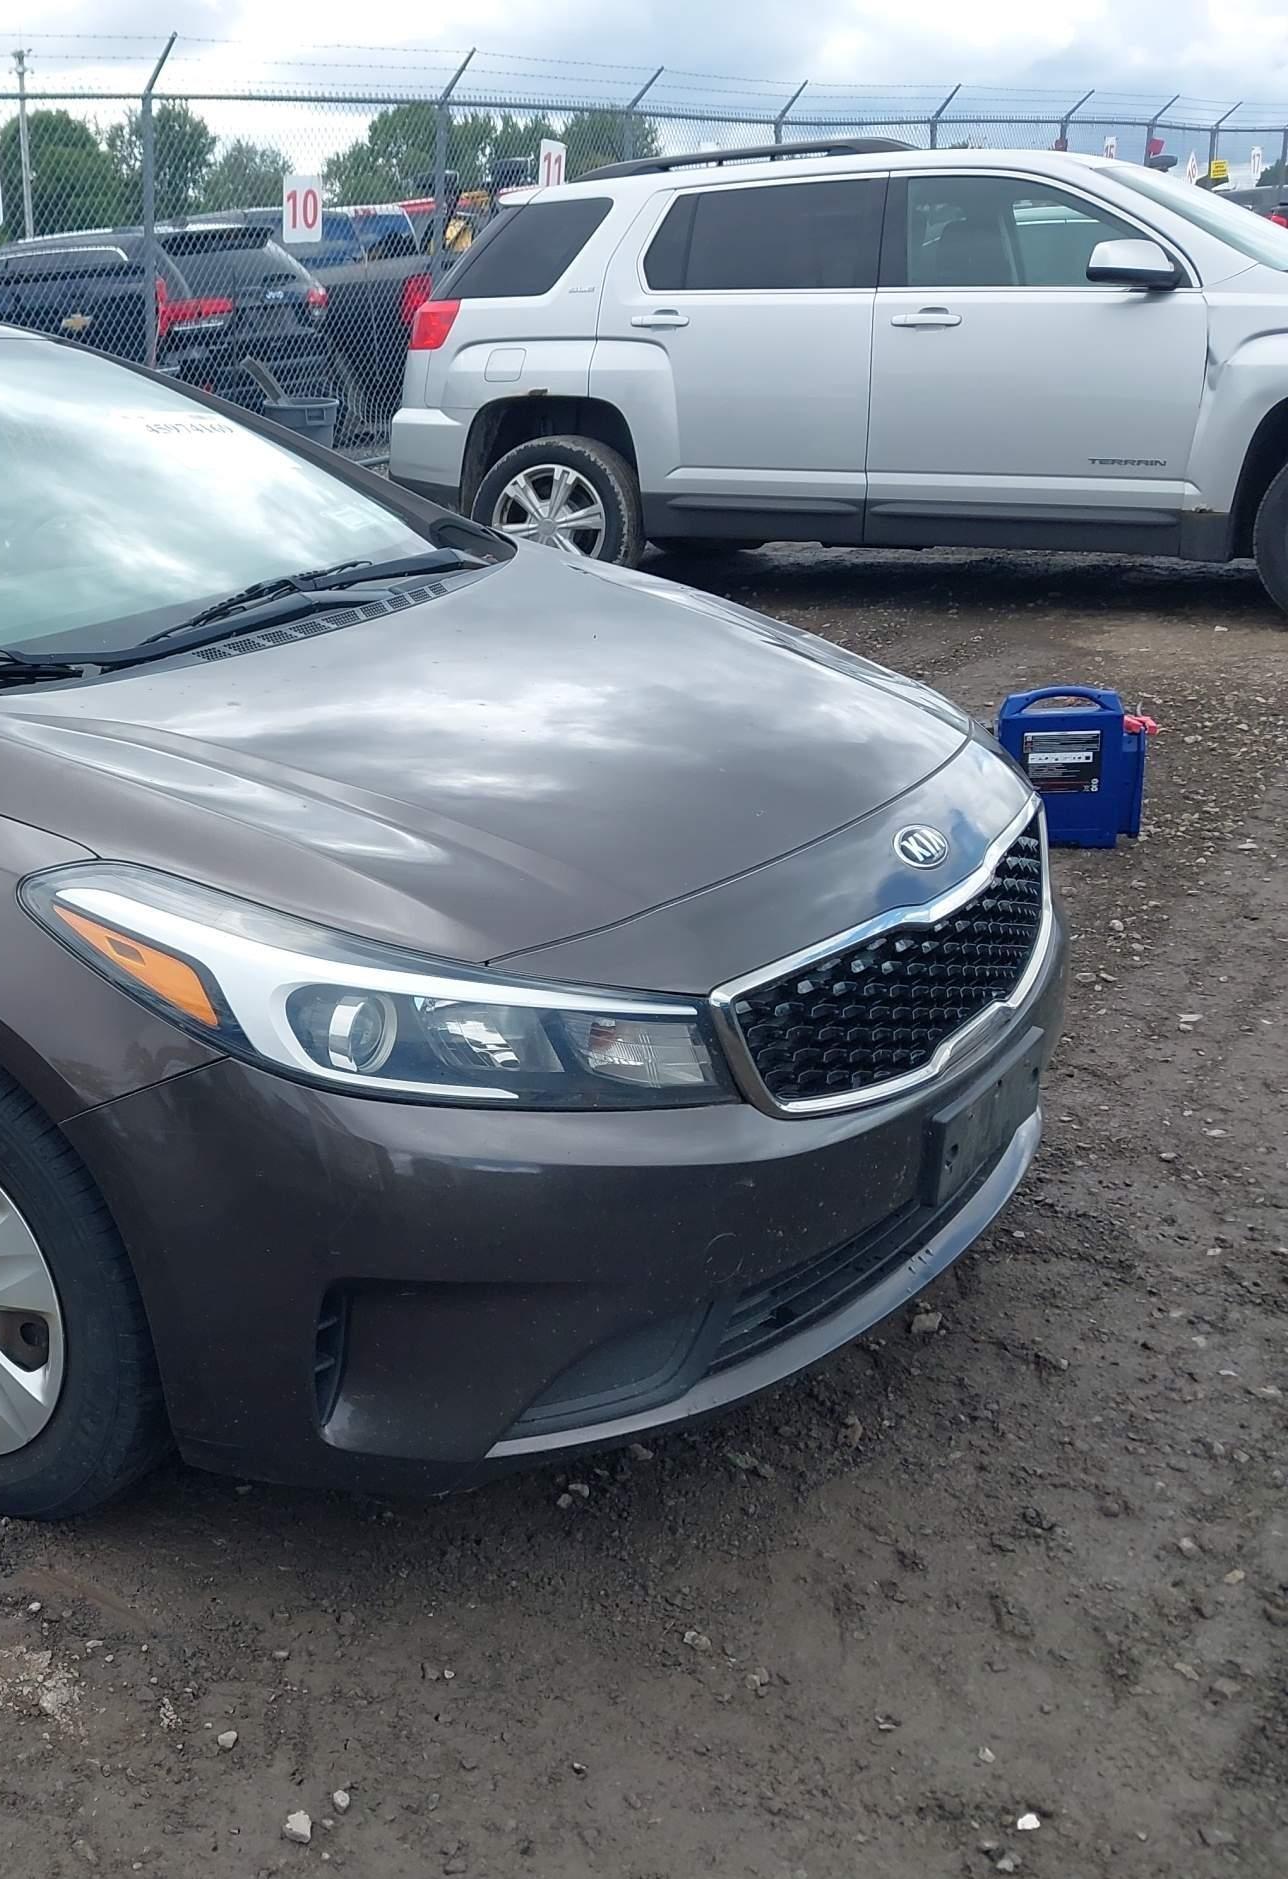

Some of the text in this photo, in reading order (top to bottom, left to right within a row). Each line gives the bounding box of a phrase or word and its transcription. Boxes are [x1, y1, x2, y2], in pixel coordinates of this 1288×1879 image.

[543, 151, 562, 187] 11
[286, 188, 318, 231] 10
[1087, 457, 1168, 467] TERRAIN
[899, 828, 946, 863] KIA
